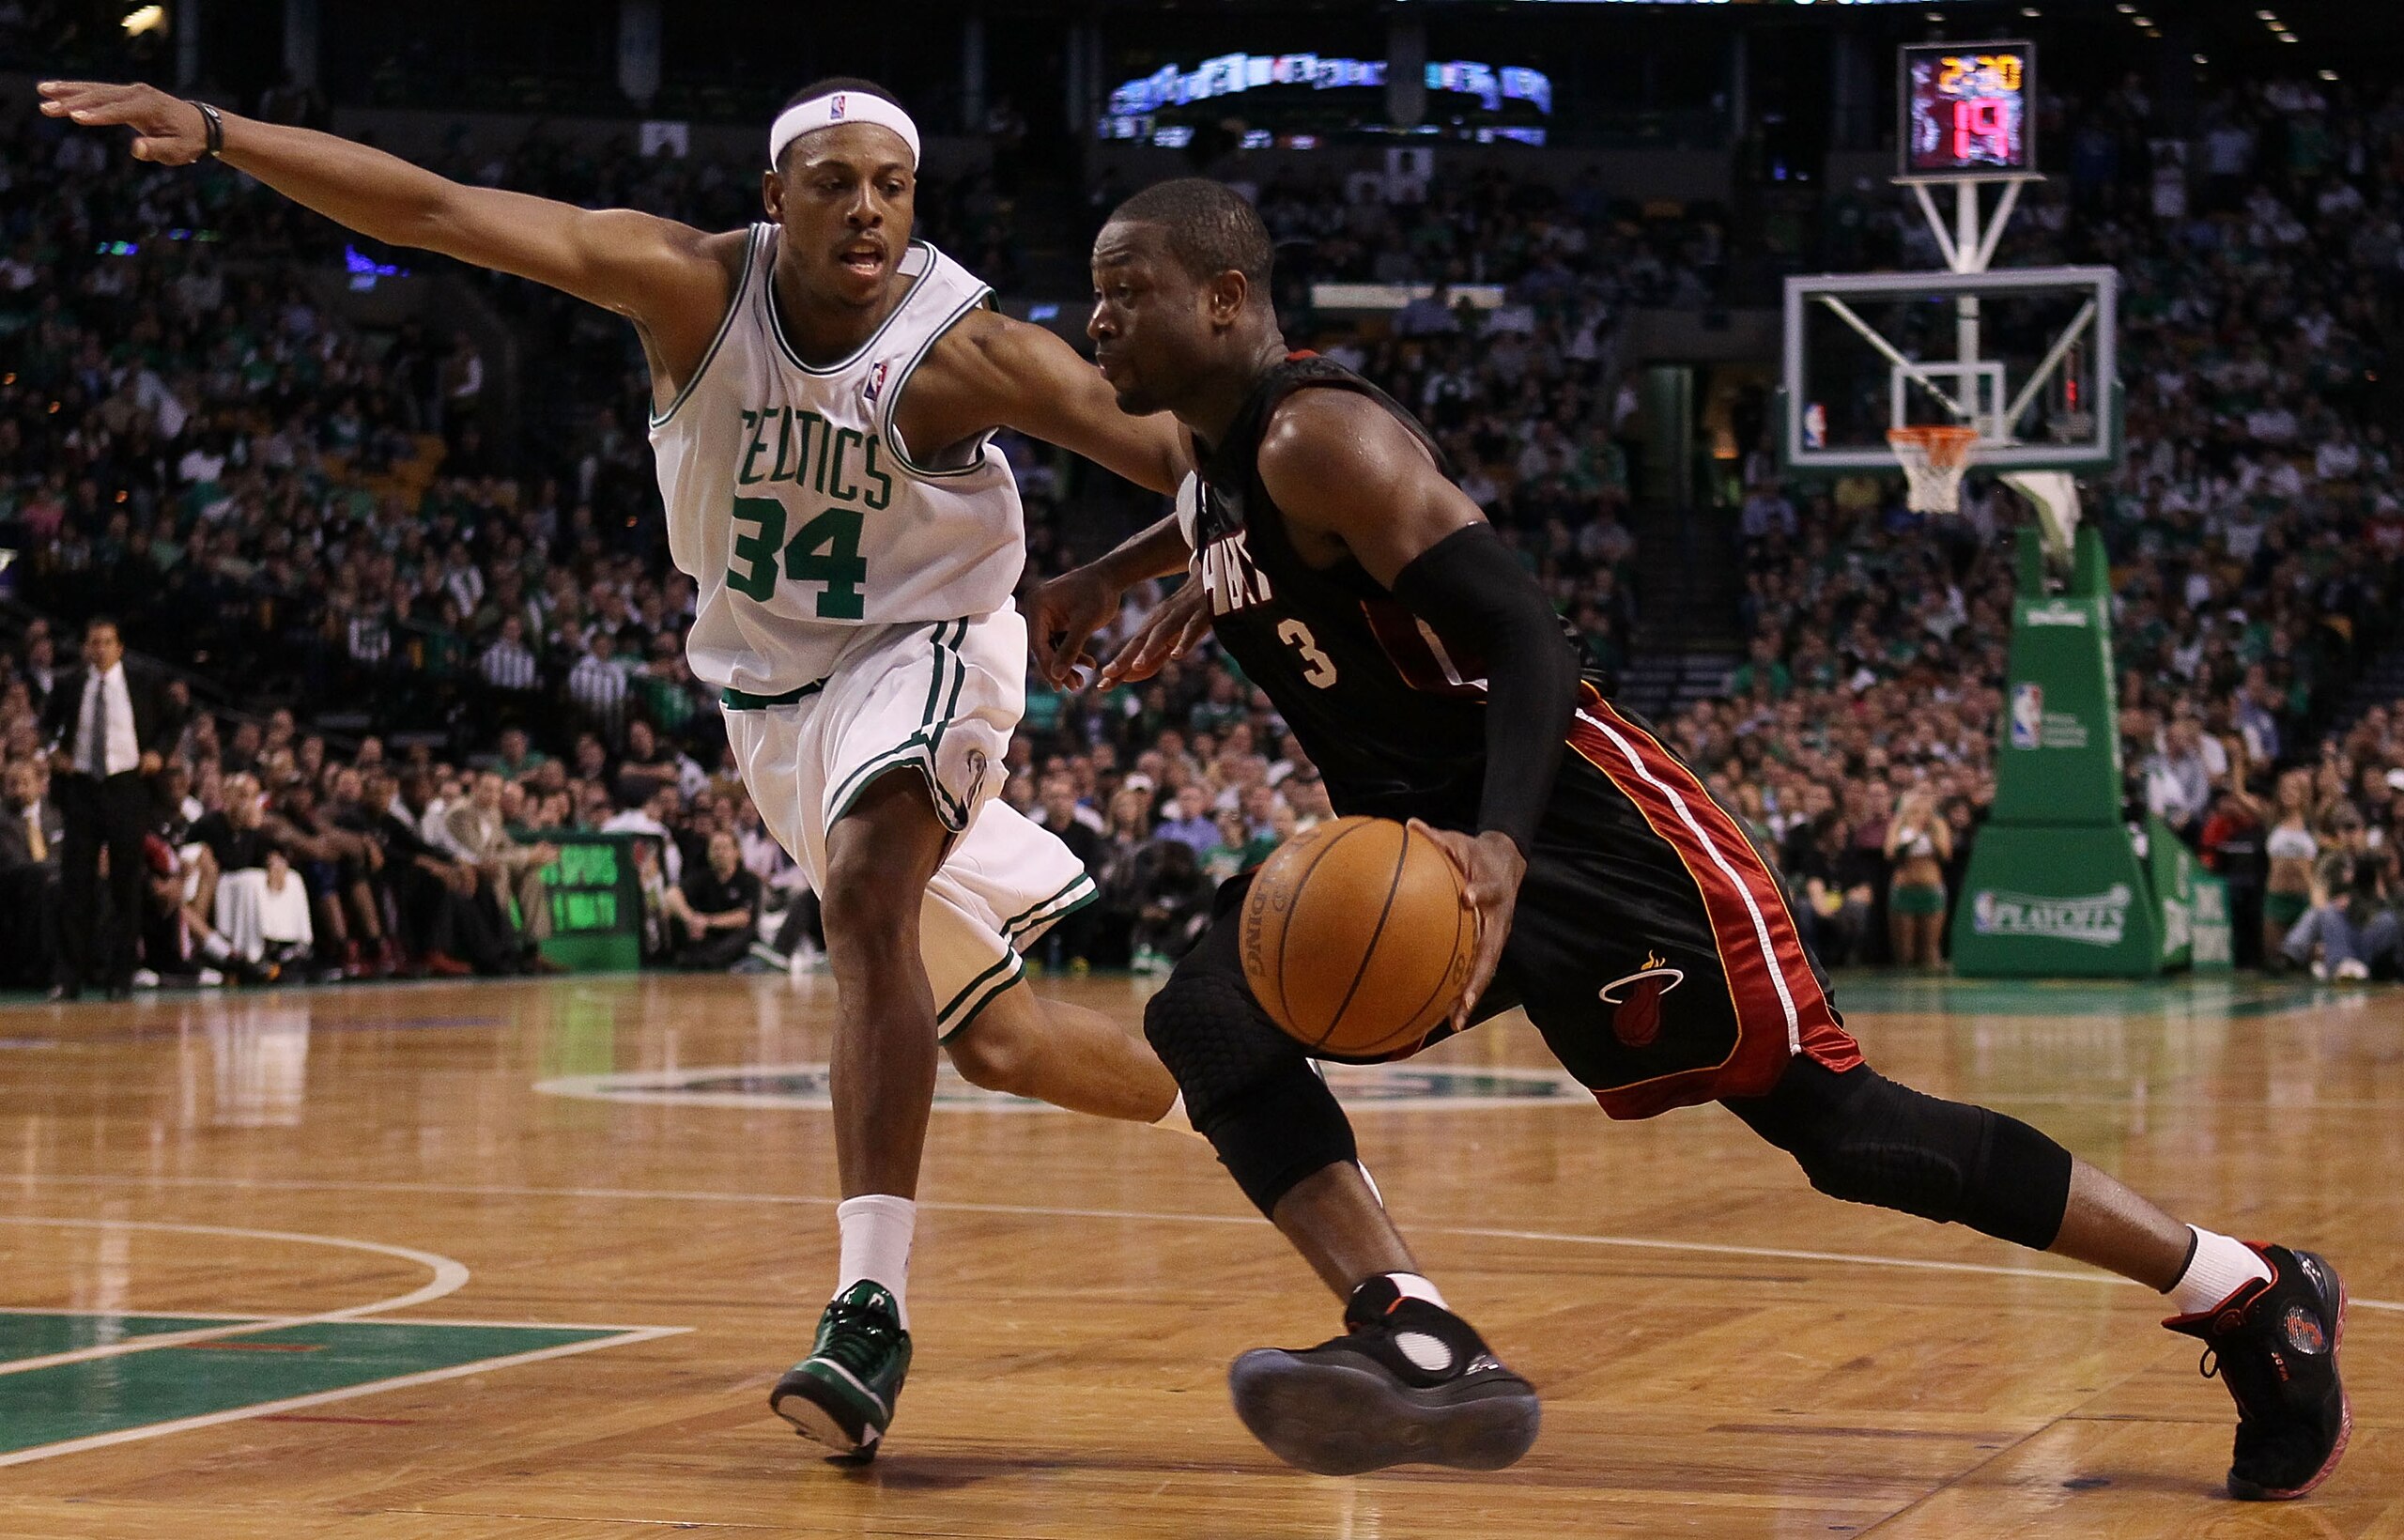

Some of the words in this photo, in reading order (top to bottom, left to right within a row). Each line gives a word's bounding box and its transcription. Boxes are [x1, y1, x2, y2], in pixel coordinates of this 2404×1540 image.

[1938, 54, 2024, 94] 2:20
[1952, 97, 2010, 160] 19
[739, 406, 891, 511] ELTICS
[726, 497, 868, 620] 34
[1277, 617, 1337, 689] 3
